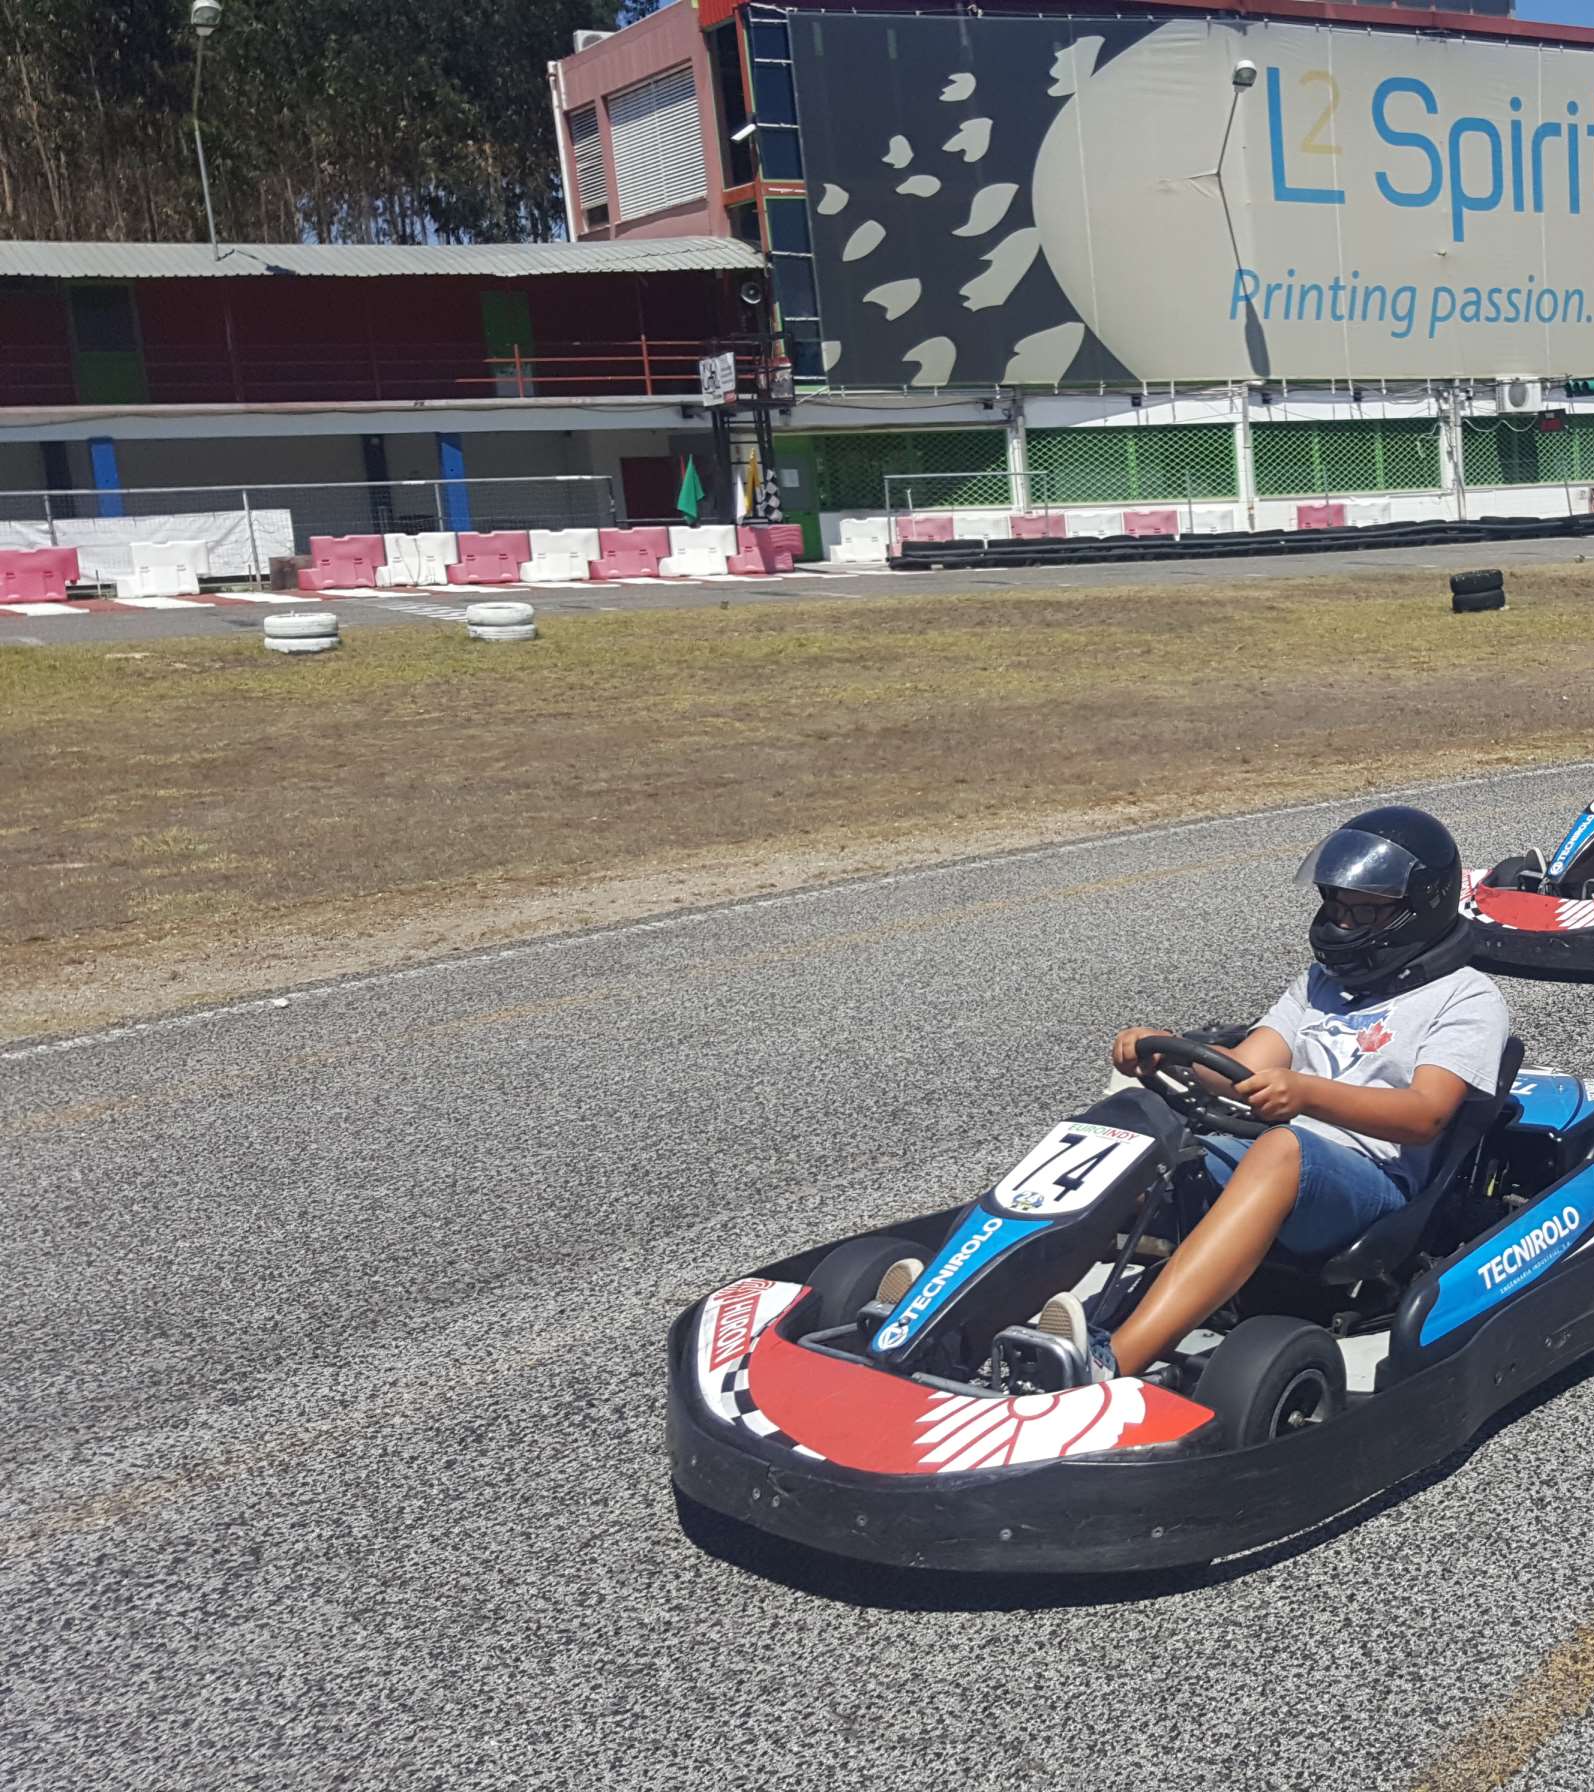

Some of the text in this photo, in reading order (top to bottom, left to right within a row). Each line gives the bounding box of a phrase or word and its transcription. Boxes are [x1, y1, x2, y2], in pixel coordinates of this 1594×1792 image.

[1229, 268, 1594, 339] Printing passion.
[1012, 1132, 1121, 1202] 74
[899, 1217, 1004, 1321] TECNIROLO
[1477, 1206, 1580, 1291] TECNIROLO
